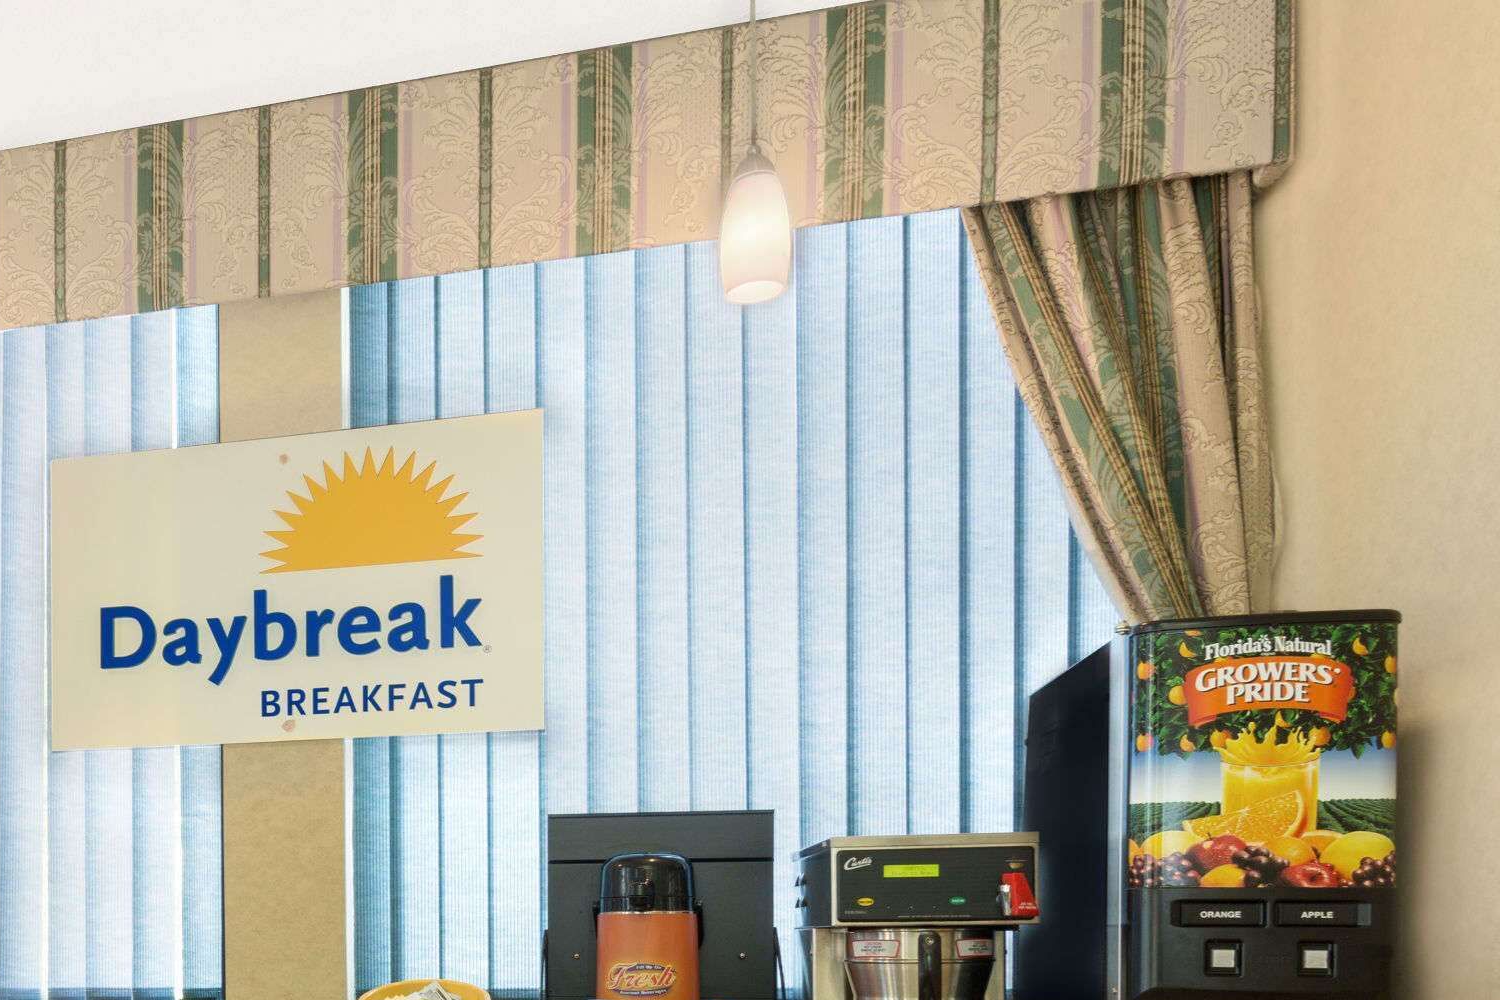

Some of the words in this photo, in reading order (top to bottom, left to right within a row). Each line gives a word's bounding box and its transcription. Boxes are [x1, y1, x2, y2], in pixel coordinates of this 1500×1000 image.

[100, 575, 482, 686] Daybreak
[1204, 634, 1271, 660] Florida's
[1274, 636, 1332, 656] Natural
[261, 678, 484, 718] BREAKFAST
[1226, 682, 1310, 705] PRIDE
[1200, 910, 1242, 919] ORANGE
[1300, 911, 1334, 919] APPLE
[607, 963, 675, 989] Fresh
